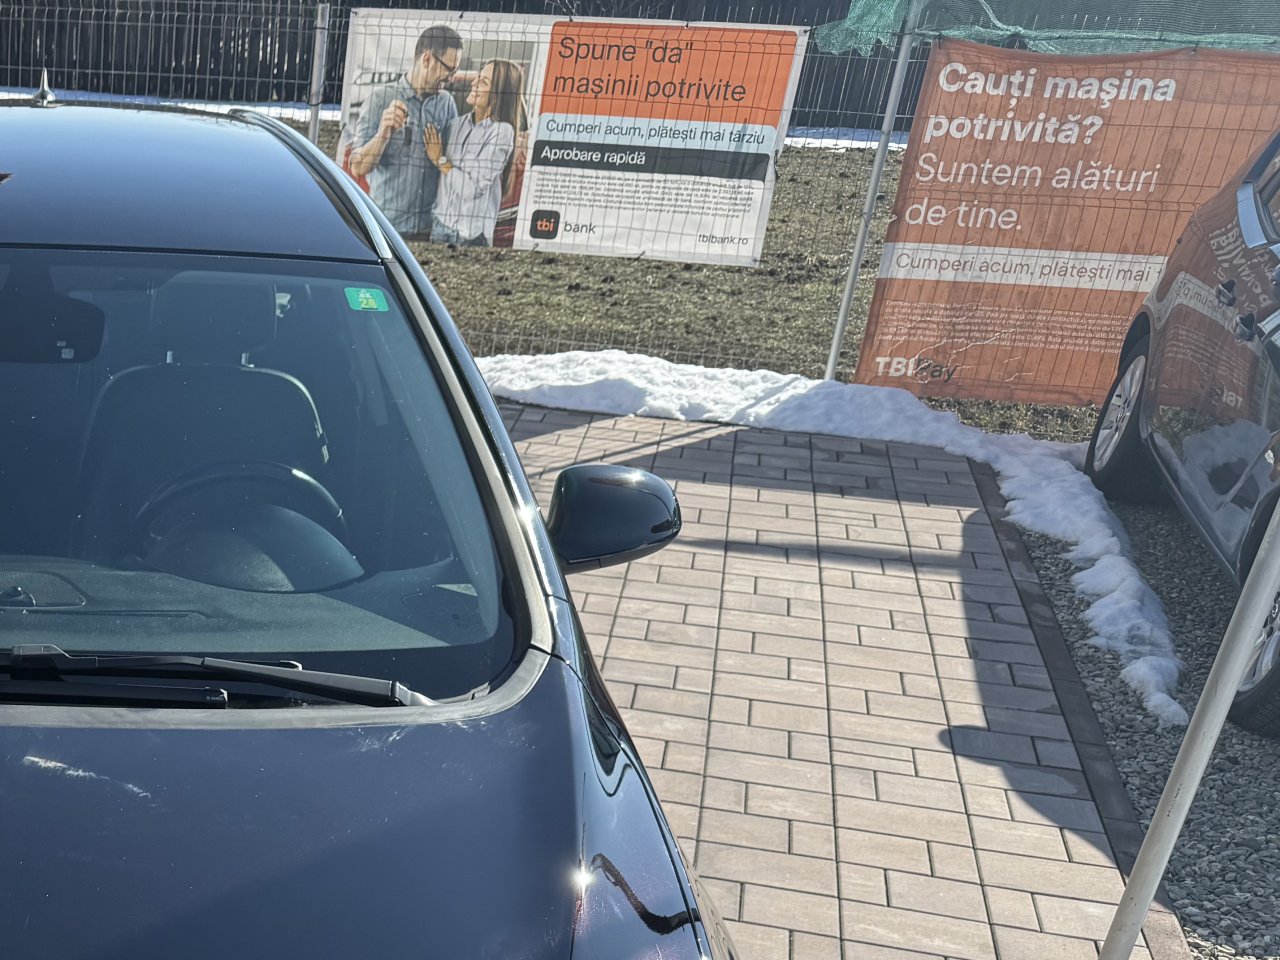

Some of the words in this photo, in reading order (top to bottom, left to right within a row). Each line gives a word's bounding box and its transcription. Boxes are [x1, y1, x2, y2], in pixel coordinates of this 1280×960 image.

[558, 36, 637, 64] Spune
[645, 39, 694, 64] "da"
[553, 73, 640, 99] mașinii
[645, 77, 747, 102] potrivite
[938, 62, 1038, 109] Cauți
[546, 119, 602, 136] Cumperi
[604, 123, 644, 140] acum,
[647, 125, 697, 143] plătești
[700, 128, 725, 143] mai
[728, 130, 766, 146] târziu
[923, 110, 1104, 145] potrivită?
[541, 145, 602, 163] Aprobare
[603, 150, 646, 167] rapidă
[915, 152, 1043, 188] Suntem
[1051, 159, 1163, 193] alături
[904, 197, 946, 226] de
[536, 218, 555, 232] tbi
[563, 221, 597, 235] bank
[895, 252, 976, 274] Cumperi
[1115, 266, 1152, 283] mai
